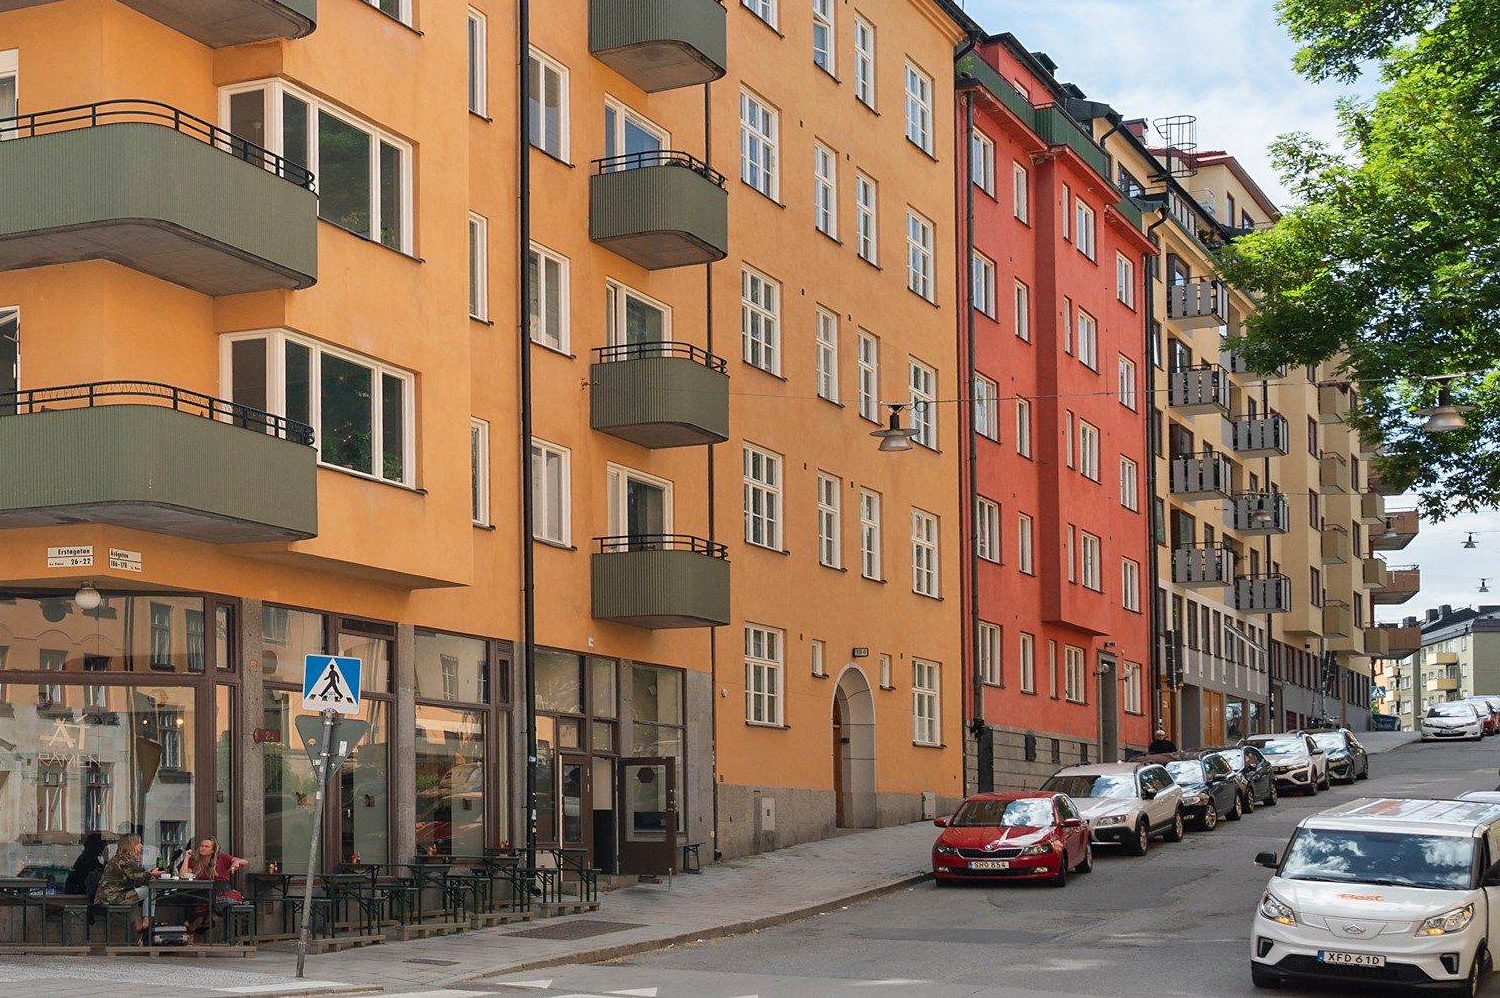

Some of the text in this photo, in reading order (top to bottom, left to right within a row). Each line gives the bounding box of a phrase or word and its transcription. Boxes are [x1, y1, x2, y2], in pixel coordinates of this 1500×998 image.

[58, 548, 90, 556] Erstagatan
[110, 550, 129, 559] Åsögatan
[38, 752, 101, 768] RAMEN
[1328, 952, 1380, 965] XFD 61D
